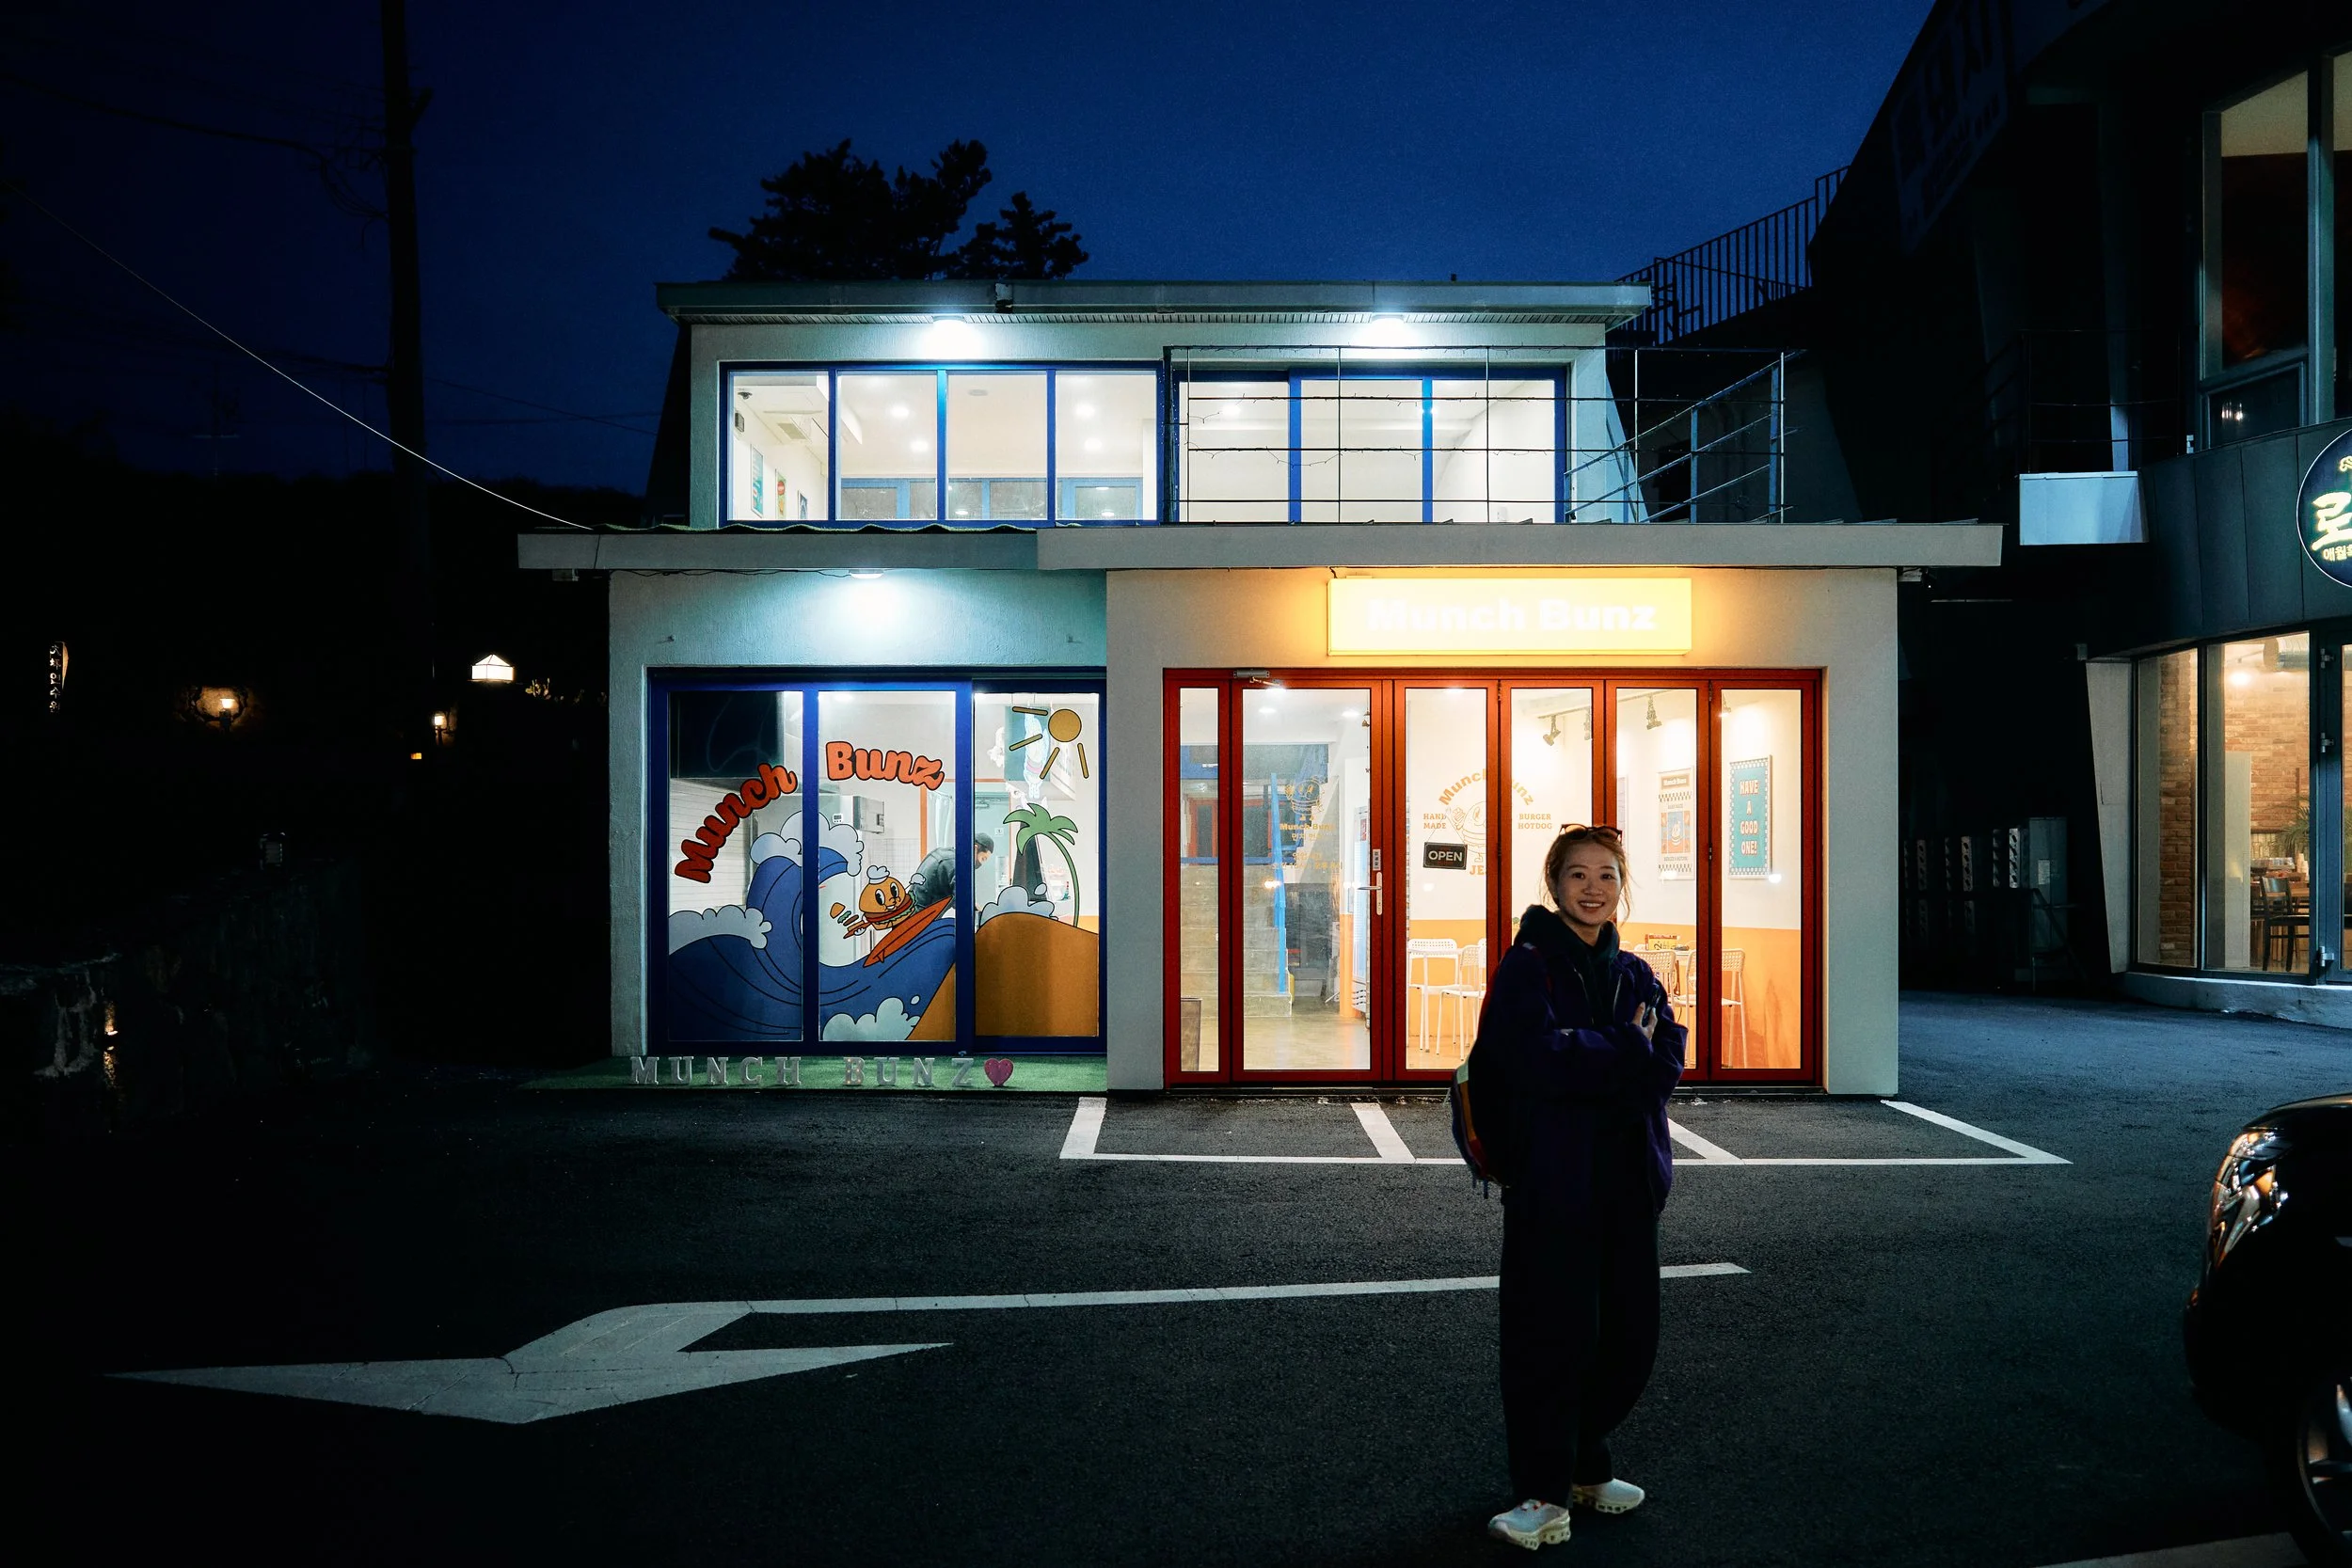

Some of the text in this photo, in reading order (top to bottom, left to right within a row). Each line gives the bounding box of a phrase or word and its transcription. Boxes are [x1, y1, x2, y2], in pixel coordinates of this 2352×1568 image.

[1367, 597, 1658, 631] Munch Bunz
[1511, 779, 1534, 806] unz
[1740, 779, 1760, 795] HAVE
[675, 741, 946, 884] Munch Bunz
[1746, 800, 1753, 815] A
[1740, 820, 1759, 835] GOOD
[1428, 850, 1463, 862] OPEN
[1740, 840, 1758, 856] ONE!
[629, 1055, 975, 1086] MUNCH BUNZ
